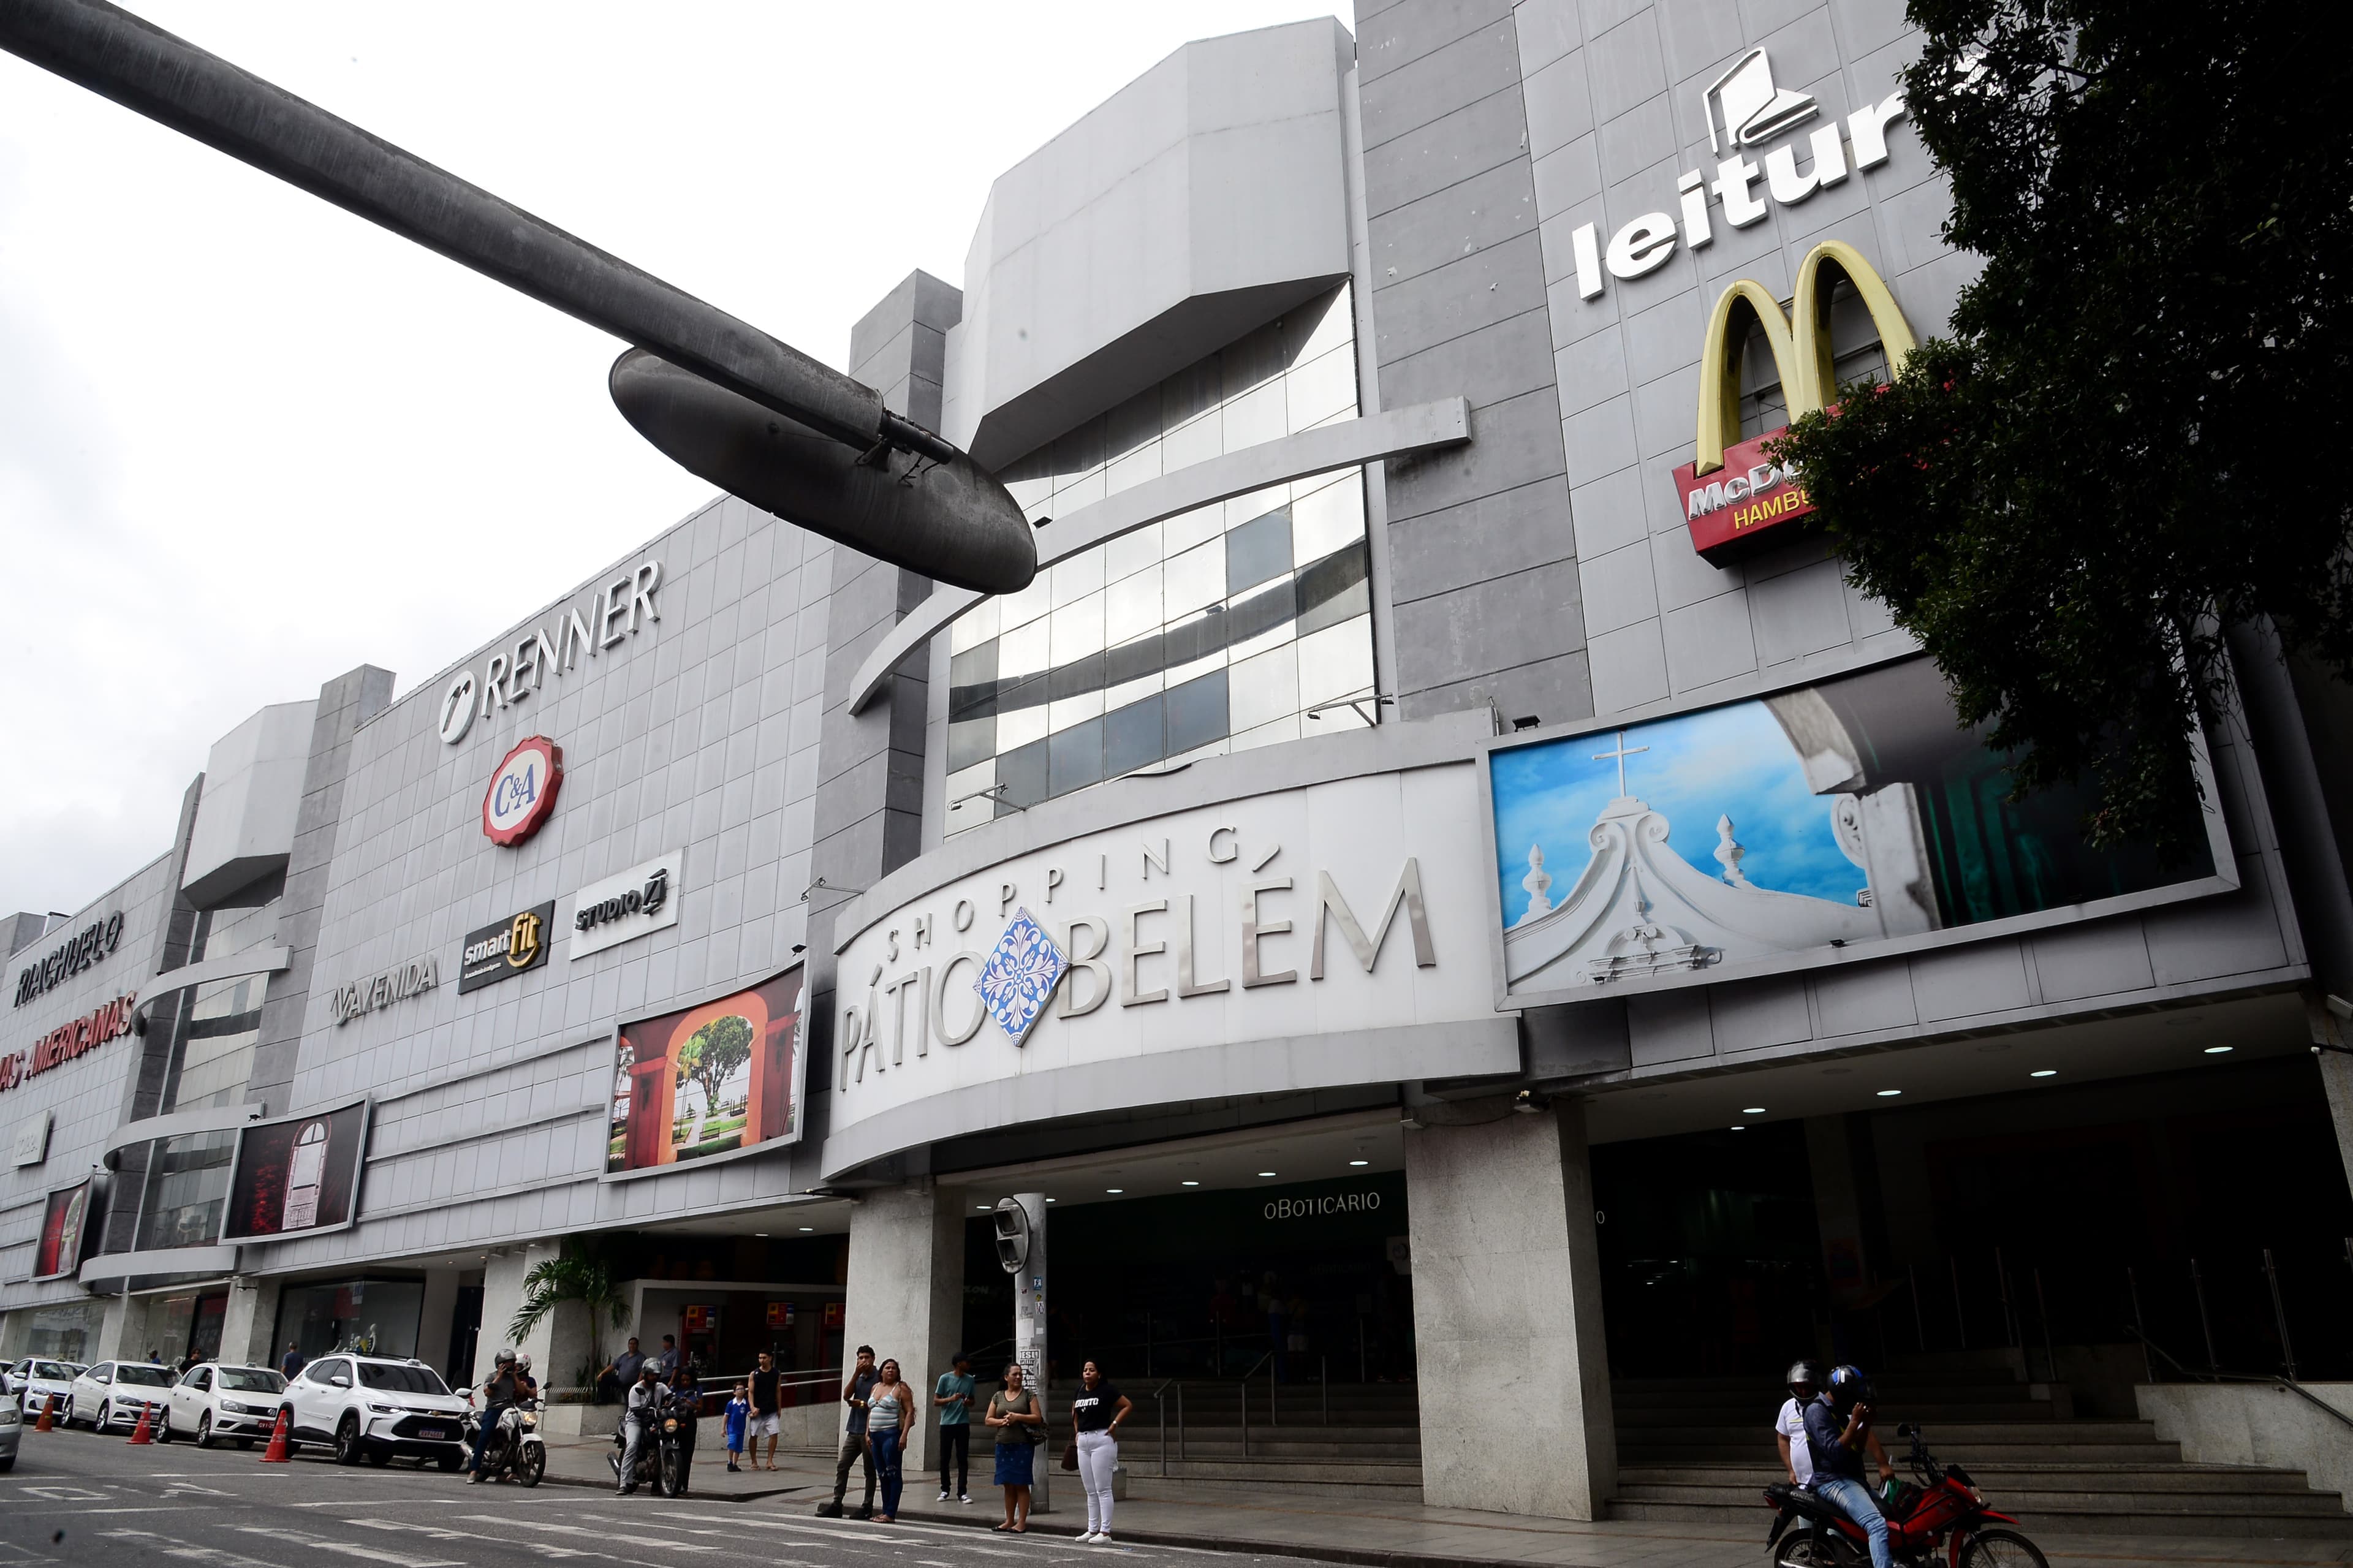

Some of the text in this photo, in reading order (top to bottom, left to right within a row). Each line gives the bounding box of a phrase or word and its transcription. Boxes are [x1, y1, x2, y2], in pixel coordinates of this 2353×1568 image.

[1572, 90, 1908, 301] leitur
[480, 559, 664, 719] RENNER
[494, 763, 536, 817] C&A
[464, 912, 540, 966] smart fit
[575, 889, 642, 931] STUDIO
[887, 825, 1238, 962] SHOPPING
[13, 909, 124, 1009] RIACHUELO
[347, 955, 439, 1018] AVENIDA
[839, 843, 1436, 1093] PÁTIO BELÉM
[24, 990, 137, 1081] AMERICANAS
